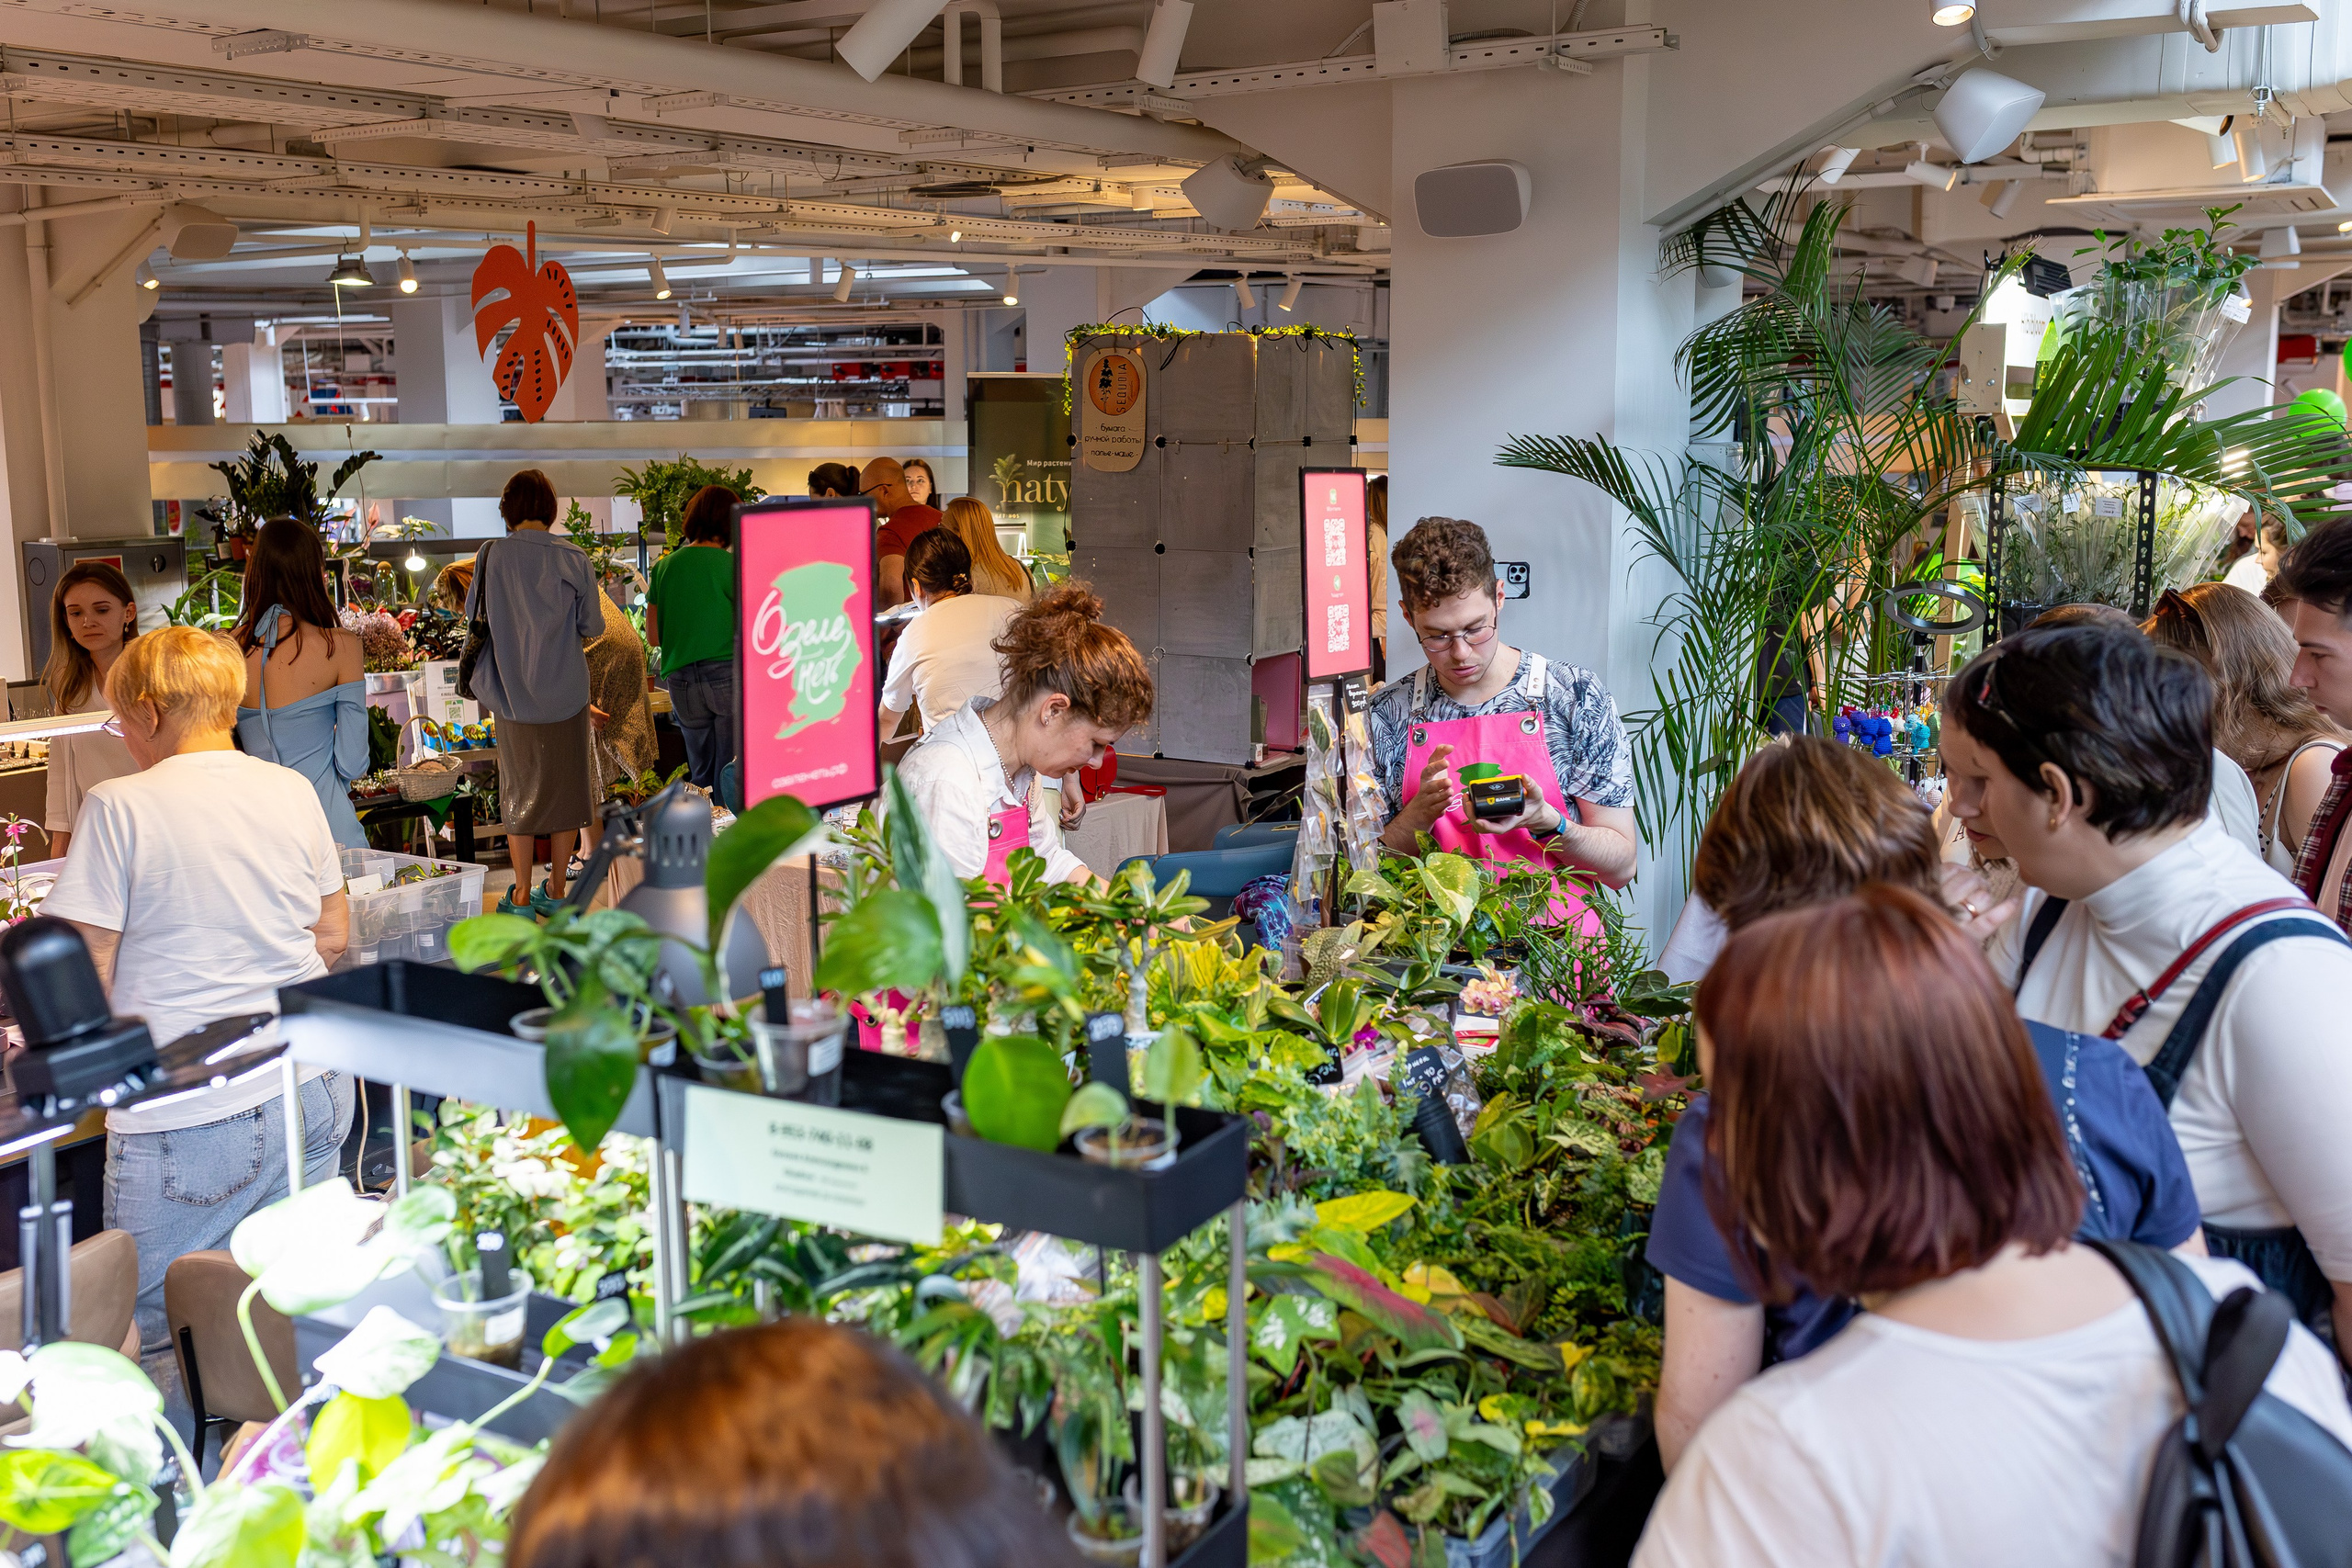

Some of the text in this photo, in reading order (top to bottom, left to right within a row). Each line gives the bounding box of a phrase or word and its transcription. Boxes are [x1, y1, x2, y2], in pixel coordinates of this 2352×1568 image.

[1116, 363, 1127, 413] SEQUOIA
[1100, 423, 1125, 433] бумага
[1084, 435, 1141, 444] ручной работы
